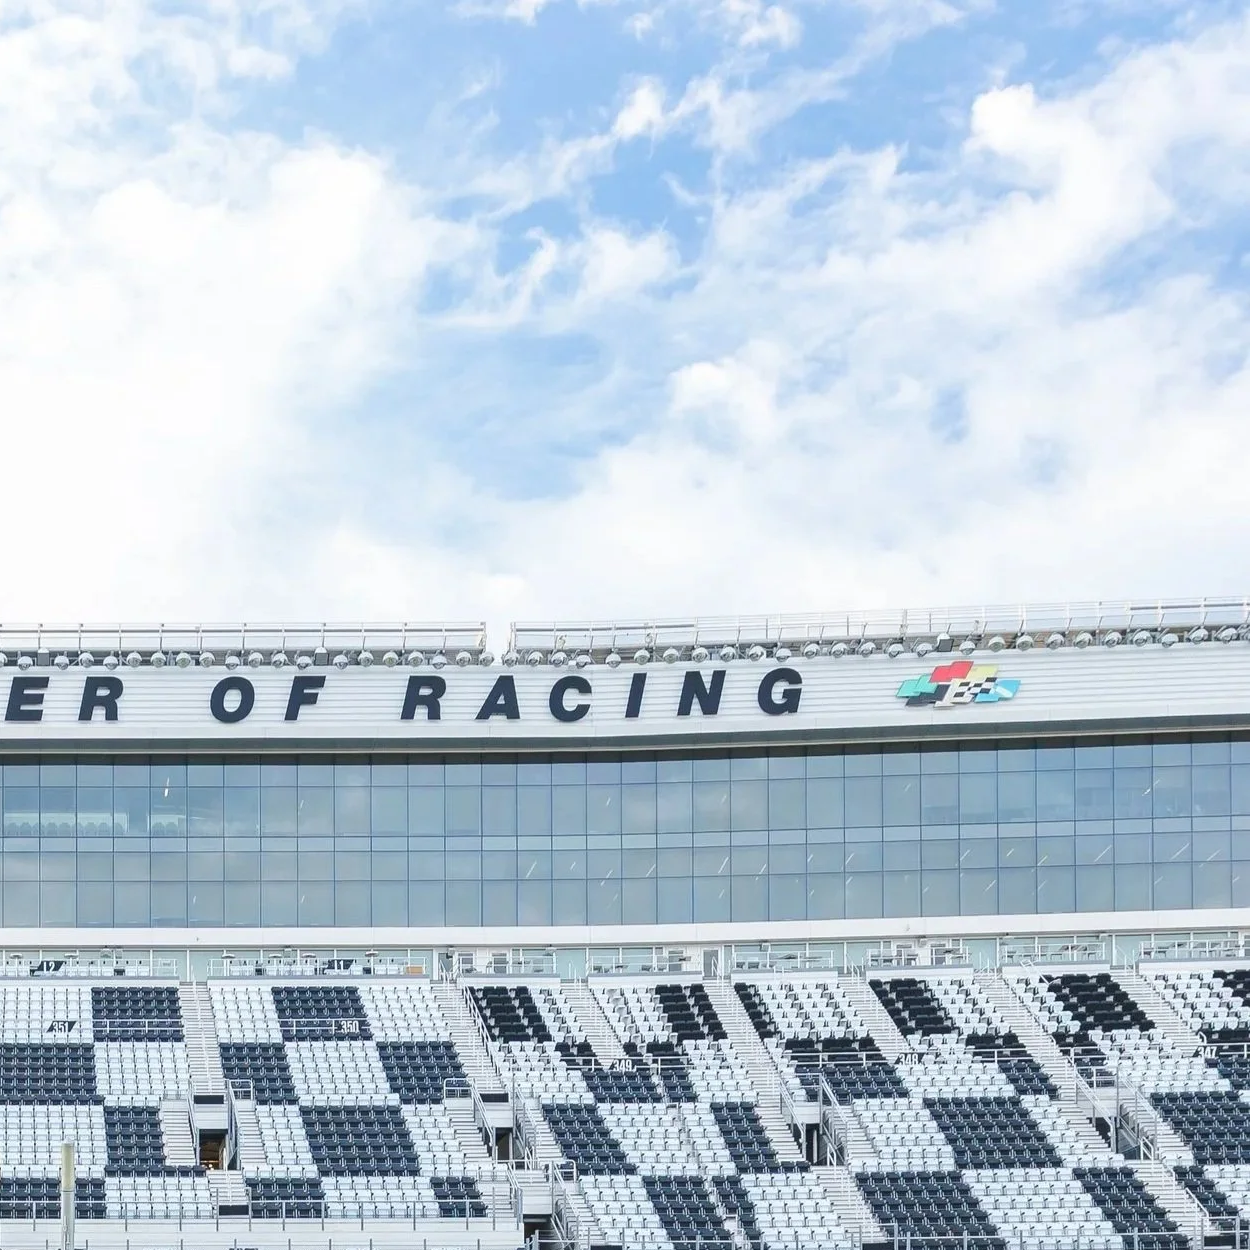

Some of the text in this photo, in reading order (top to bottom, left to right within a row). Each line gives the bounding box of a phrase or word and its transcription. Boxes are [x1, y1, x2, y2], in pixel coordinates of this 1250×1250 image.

[210, 675, 327, 724] OF
[400, 667, 803, 722] RACING
[52, 1021, 68, 1033] 351
[340, 1020, 360, 1033] 350
[899, 1053, 919, 1065] 348
[1198, 1046, 1217, 1059] 347
[613, 1059, 632, 1072] 349
